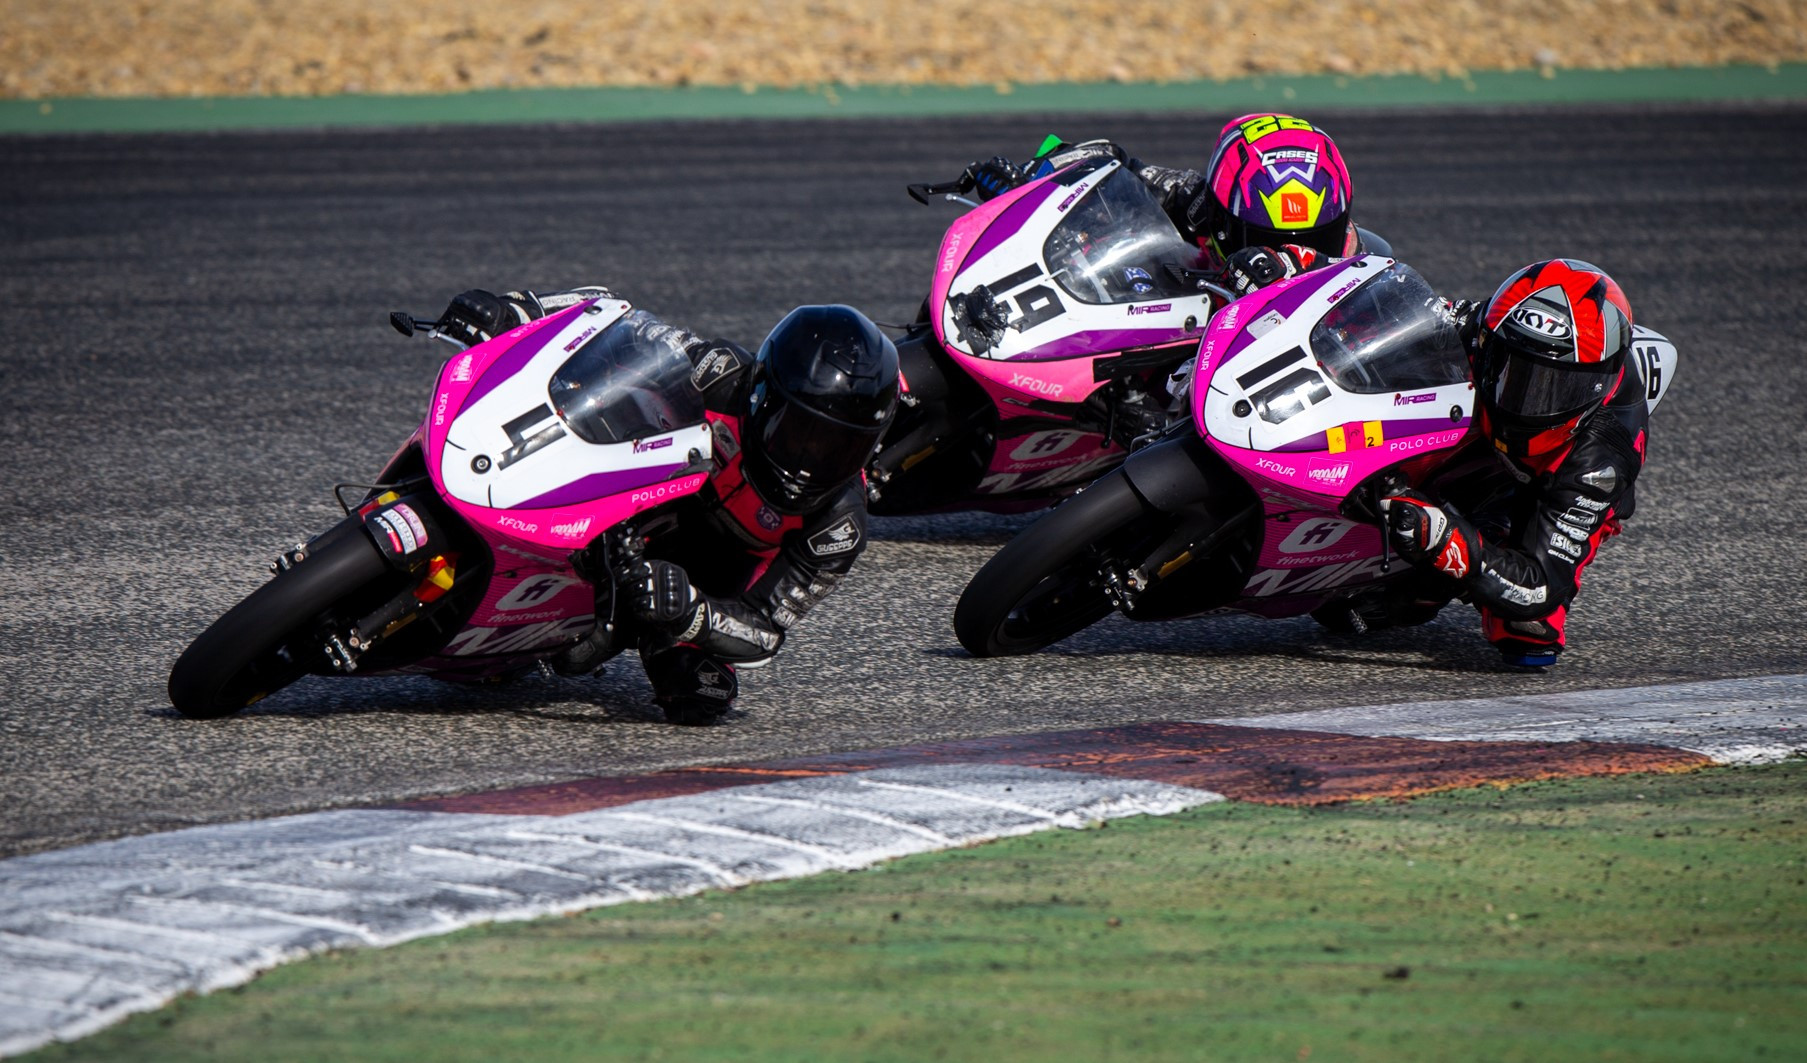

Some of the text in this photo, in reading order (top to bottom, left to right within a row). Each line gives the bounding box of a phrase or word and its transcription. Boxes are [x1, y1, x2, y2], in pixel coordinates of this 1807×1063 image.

[1261, 150, 1319, 167] CASES
[940, 232, 964, 273] XFOUR
[983, 261, 1067, 333] 19
[1127, 305, 1150, 316] MIR
[1516, 308, 1570, 338] KYT
[1201, 340, 1215, 371] XFOUR
[1635, 345, 1663, 400] 16
[1008, 372, 1064, 398] XFOUR
[1235, 345, 1332, 424] 16
[434, 392, 449, 426] XFOUR
[1393, 395, 1415, 407] MIR
[497, 402, 567, 471] 4
[633, 440, 654, 454] MIR
[1366, 436, 1375, 448] 2
[1389, 432, 1459, 452] POLO CLUB
[1255, 457, 1297, 478] XFOUR
[631, 477, 702, 503] POLO CLUB
[497, 515, 539, 534] XFOUR
[1276, 549, 1360, 566] finetwork
[487, 607, 563, 624] finetwork
